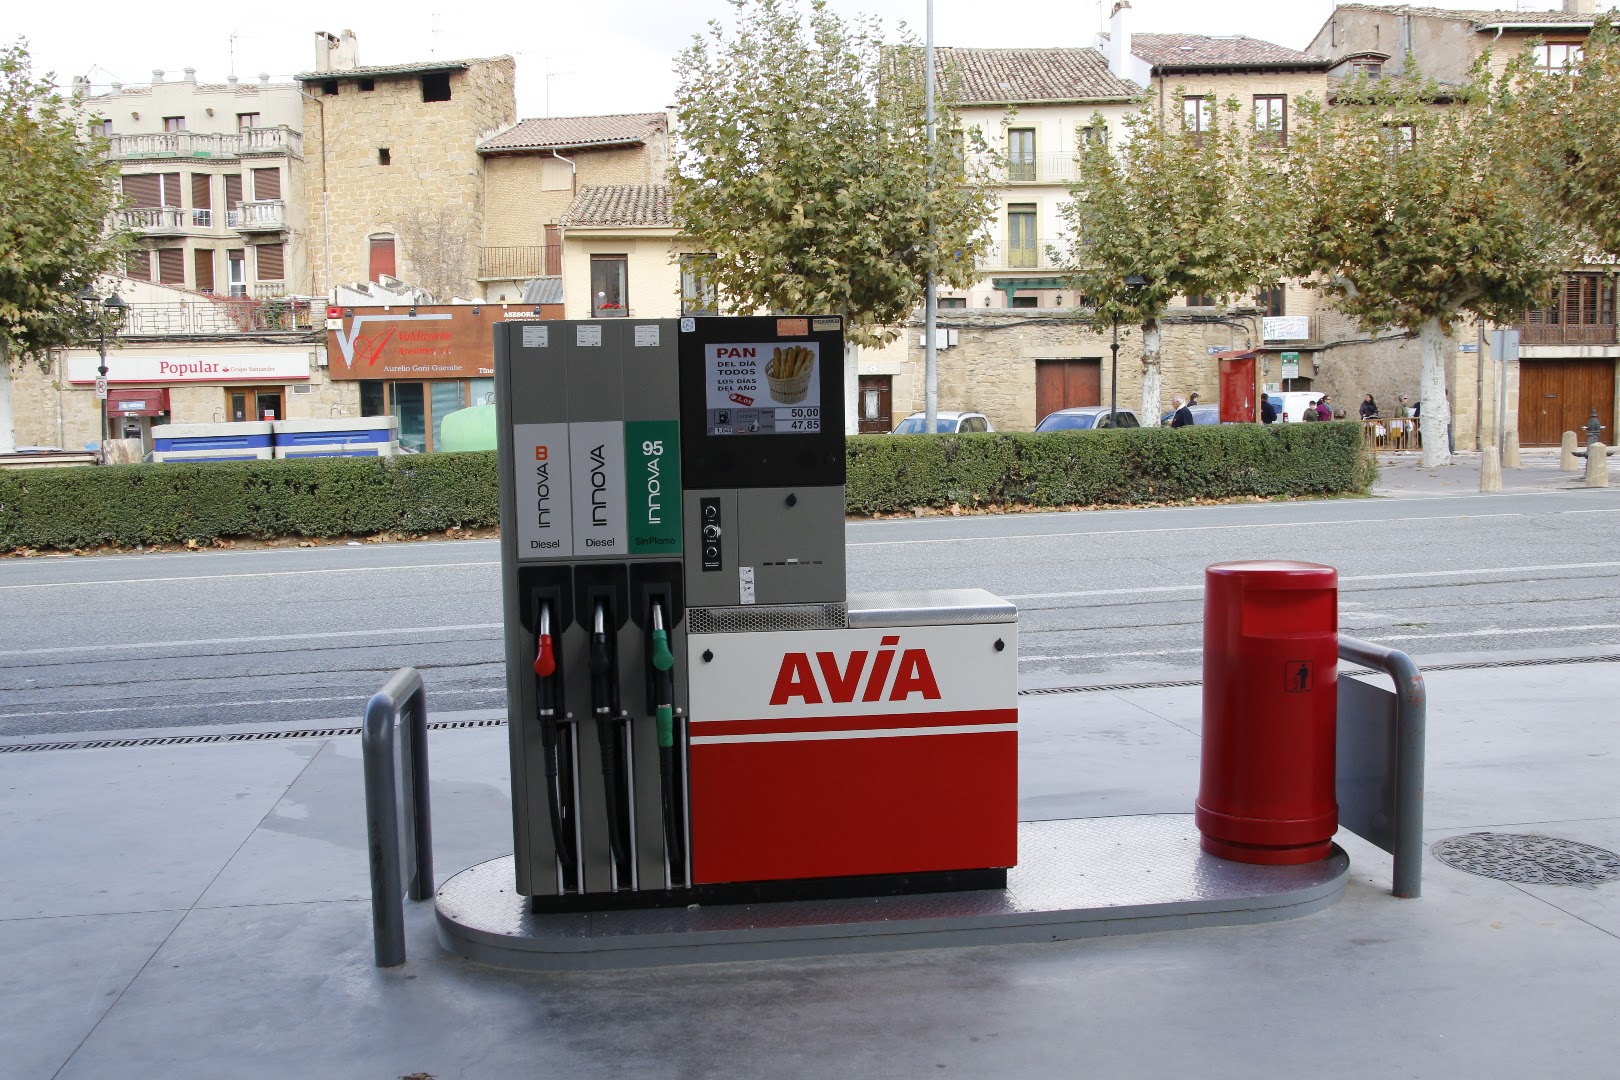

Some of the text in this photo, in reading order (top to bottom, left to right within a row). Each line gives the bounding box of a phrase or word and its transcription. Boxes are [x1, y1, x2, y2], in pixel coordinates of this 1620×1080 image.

[716, 347, 756, 358] PAN
[160, 360, 219, 377] Popular
[791, 408, 819, 418] 50,00
[791, 420, 819, 430] 47,85
[535, 446, 548, 460] B
[642, 440, 664, 456] 95
[531, 540, 560, 549] Diesel
[585, 538, 615, 547] Diesel
